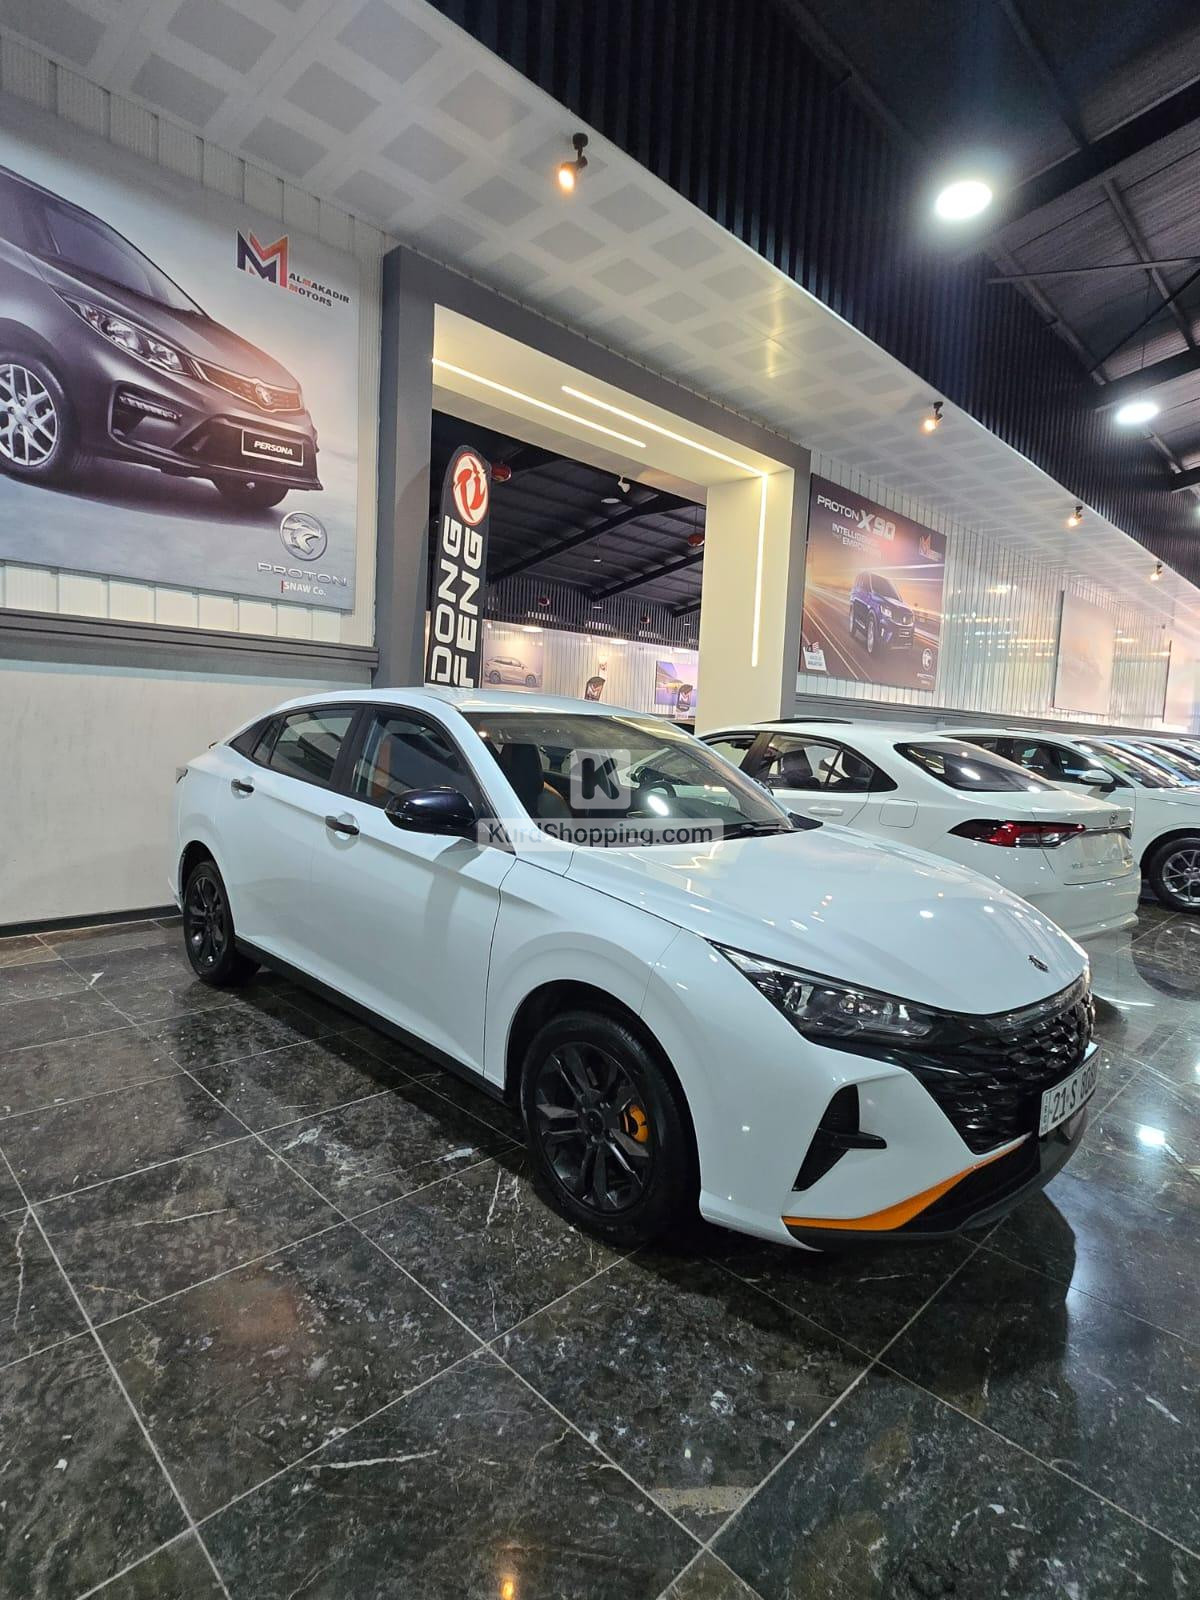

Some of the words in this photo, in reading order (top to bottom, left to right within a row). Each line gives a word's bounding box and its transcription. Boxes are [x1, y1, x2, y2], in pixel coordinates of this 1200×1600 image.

[288, 272, 350, 304] ALMAKADIR
[288, 283, 333, 307] MOTORS
[254, 440, 294, 456] PERSONA
[816, 494, 860, 521] PROTON
[856, 509, 897, 542] X90
[832, 522, 881, 550] INTELLIGEN
[257, 561, 349, 587] PROTON
[284, 581, 312, 594] SNAW
[313, 586, 327, 596] Co.
[431, 515, 462, 684] DONG
[453, 526, 483, 688] FENG
[1051, 1086, 1067, 1124] 21
[1069, 1079, 1078, 1110] S
